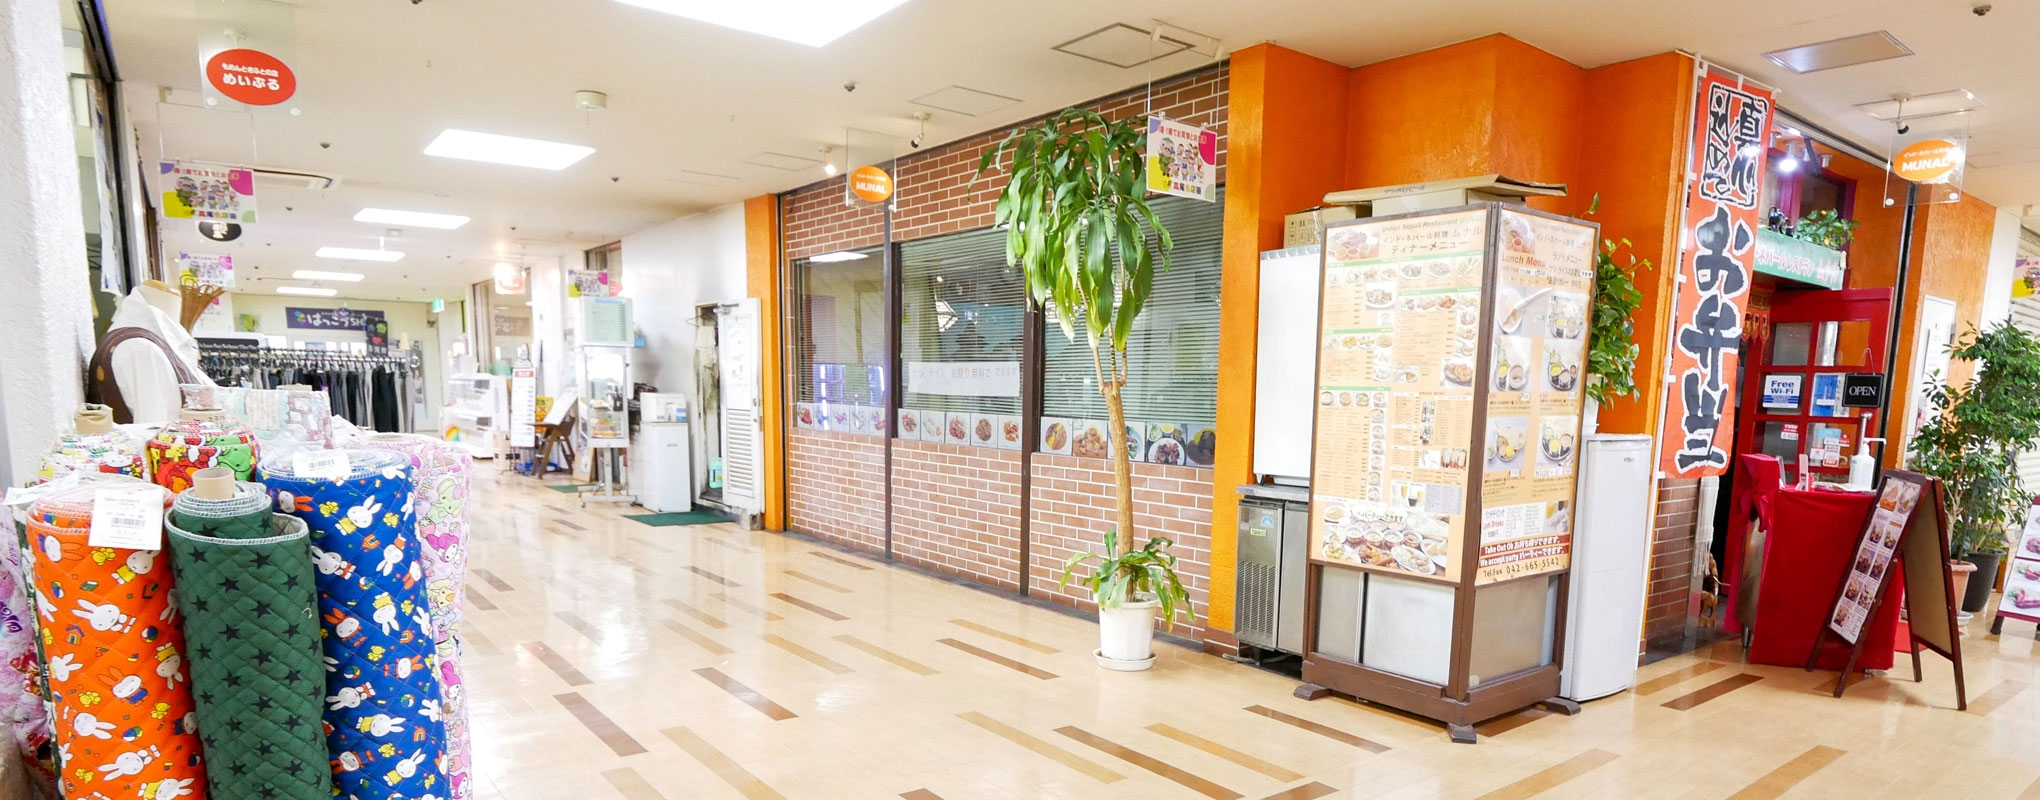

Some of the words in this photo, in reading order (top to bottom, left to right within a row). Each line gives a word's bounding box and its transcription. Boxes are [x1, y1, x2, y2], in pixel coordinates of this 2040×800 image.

[1902, 158, 1951, 172] MUNAL
[856, 181, 887, 194] MUNAL
[1423, 218, 1458, 228] Restaurant
[1502, 252, 1524, 264] Lunch
[1771, 380, 1795, 388] Free
[1848, 386, 1877, 396] OPEN
[1484, 546, 1497, 554] Take
[1497, 543, 1508, 552] Out
[1480, 558, 1488, 567] We
[1488, 555, 1506, 566] accept
[1506, 553, 1519, 564] party
[1483, 569, 1503, 578] Tel.Fax
[1506, 557, 1560, 575] 042-665-5542
